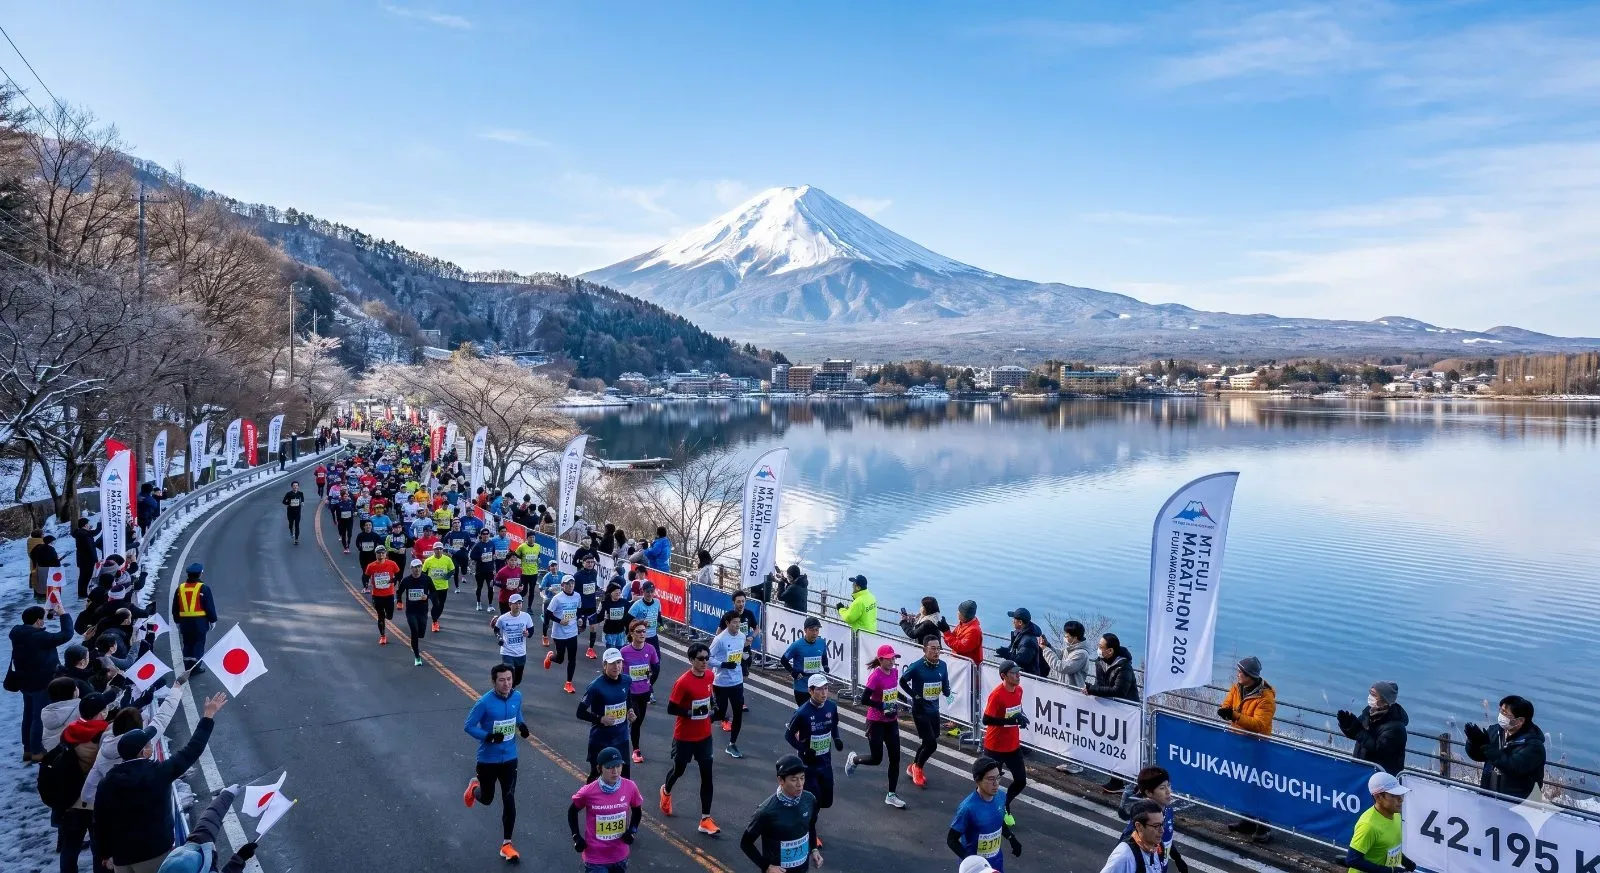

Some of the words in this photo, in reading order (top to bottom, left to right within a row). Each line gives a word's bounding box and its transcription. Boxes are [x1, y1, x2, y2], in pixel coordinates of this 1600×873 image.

[752, 486, 766, 548] MARATHON
[749, 552, 759, 577] 2026
[1165, 530, 1180, 613] FUJIKAWAGUCHI-KO
[1174, 532, 1197, 632] MARATHON
[826, 639, 844, 662] KM
[1170, 637, 1188, 675] 2026
[1034, 721, 1096, 752] MARATHON
[1099, 741, 1127, 760] 2026
[1035, 696, 1071, 728] MT.
[1076, 707, 1127, 745] FUJI
[1169, 743, 1361, 814] FUJIKAWAGUCHI-KO
[599, 819, 624, 832] 1438
[1420, 809, 1559, 873] 42.195
